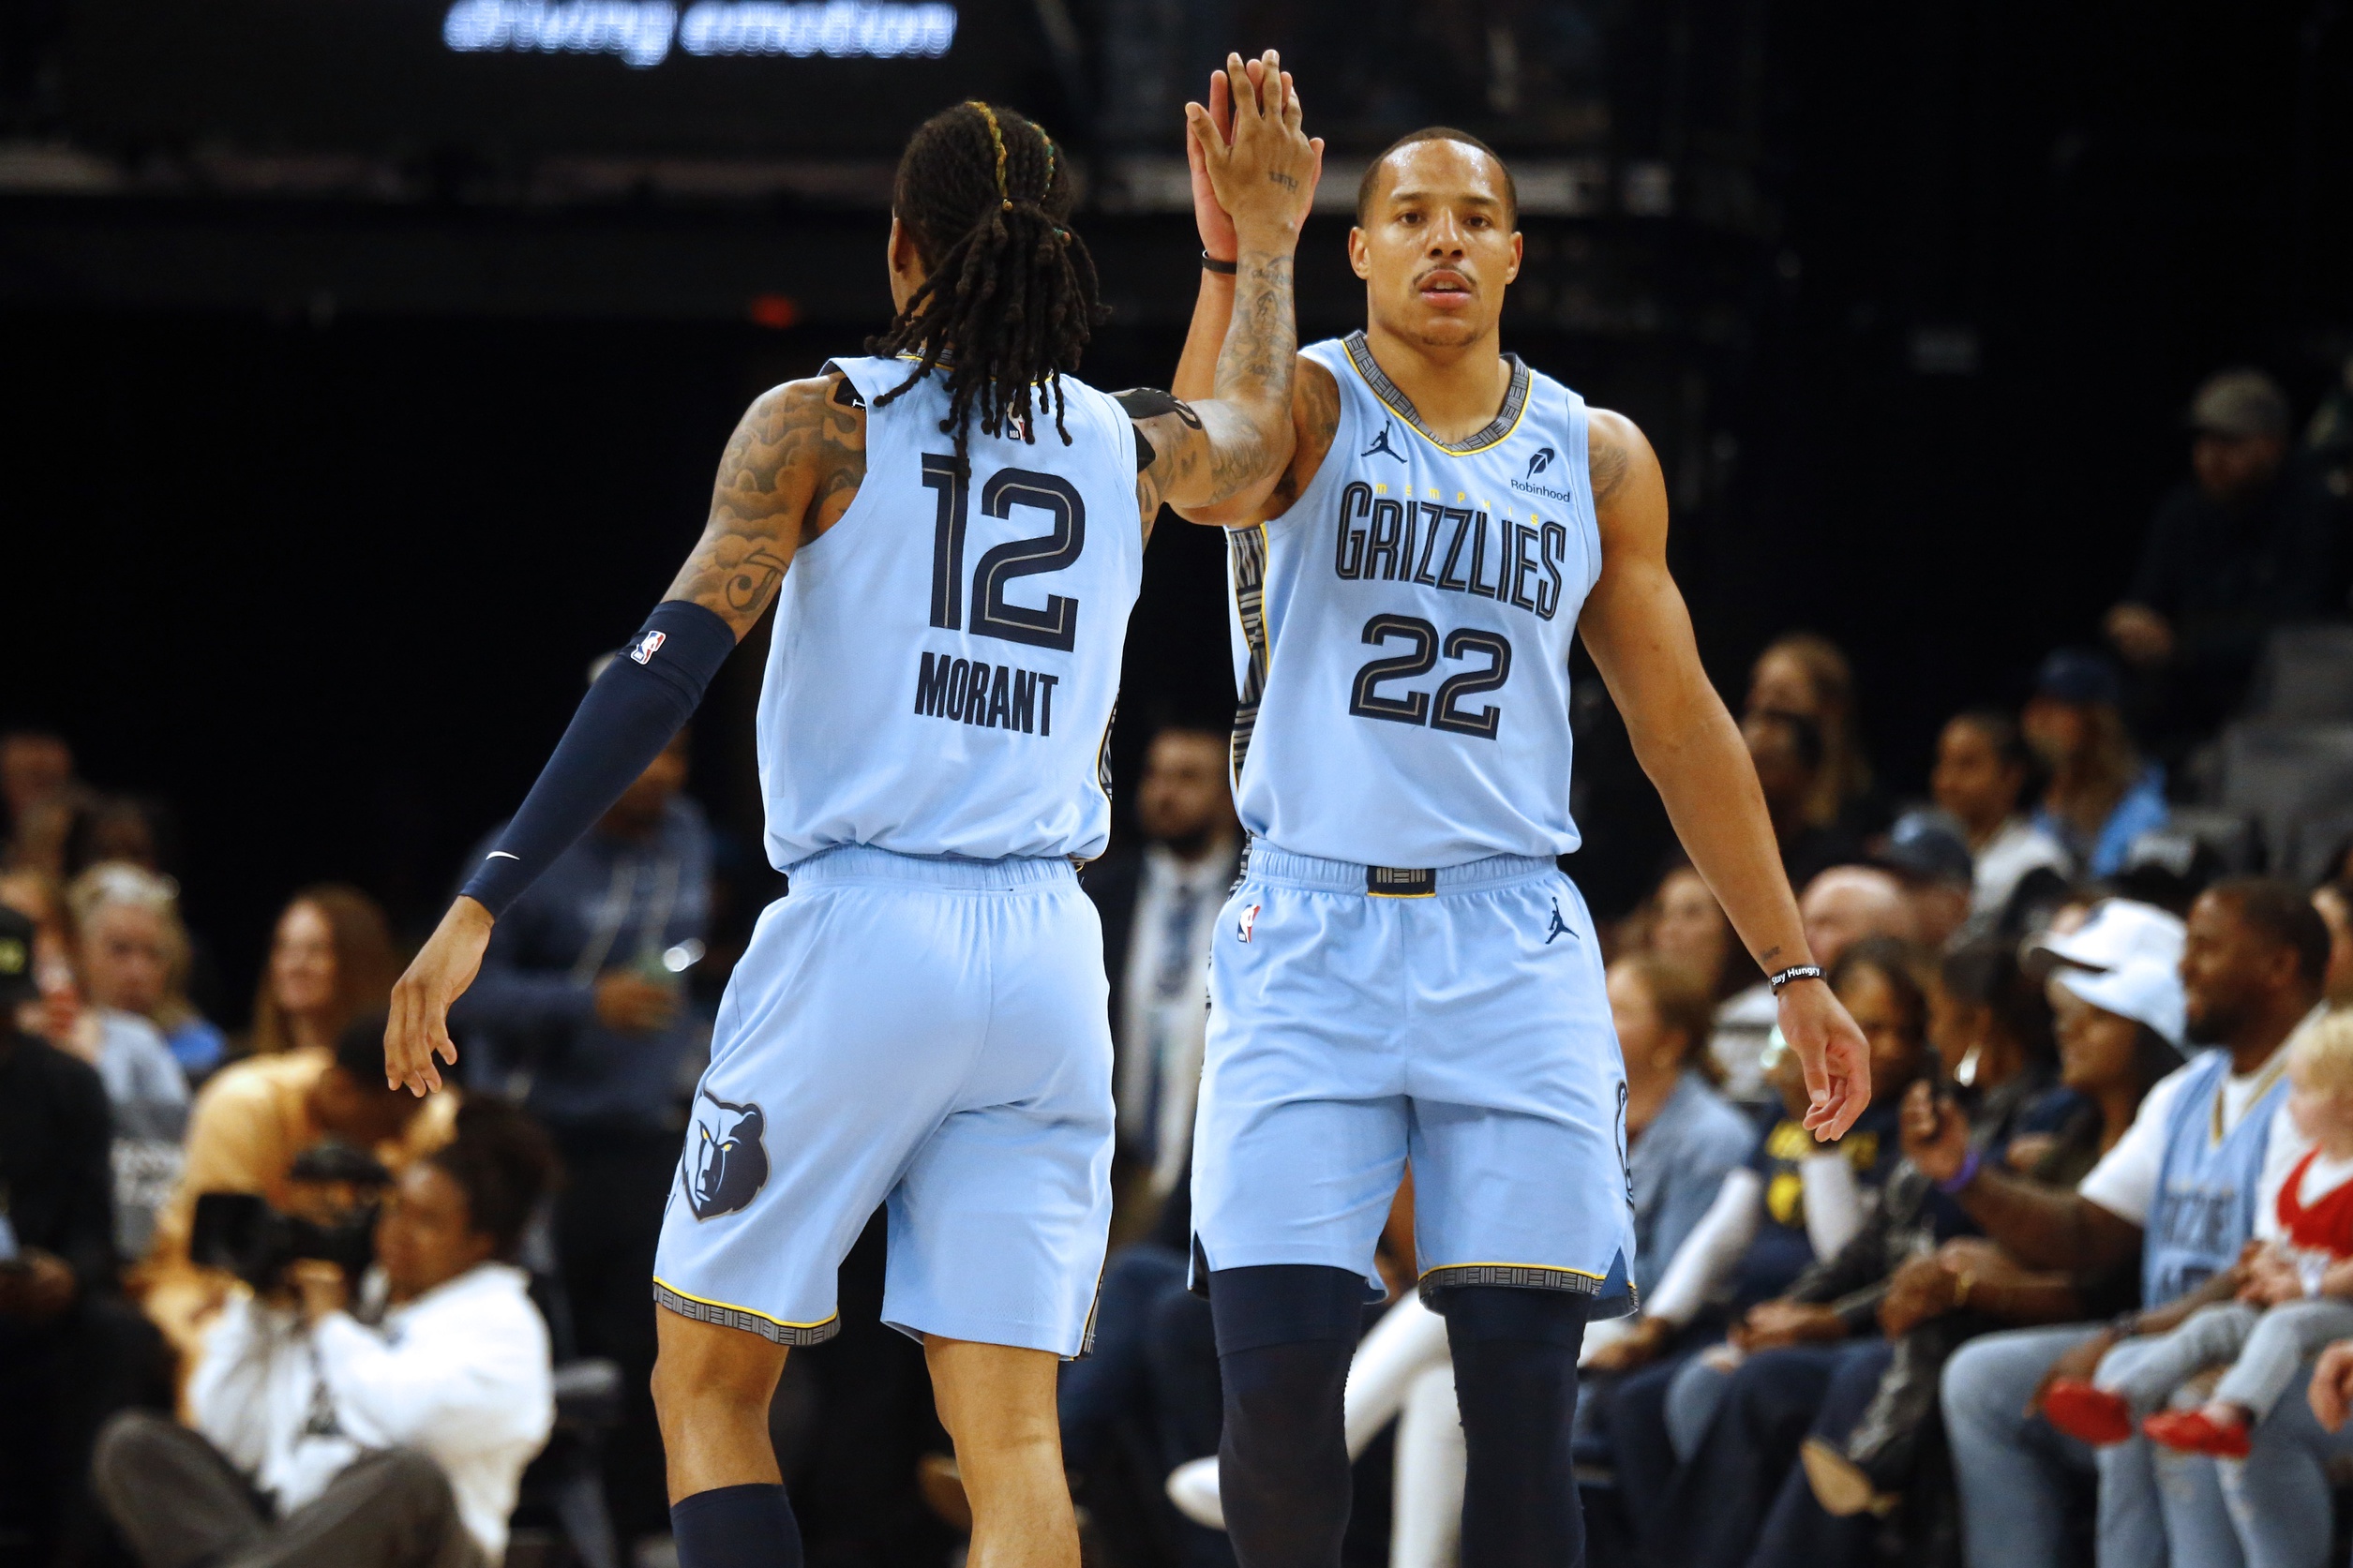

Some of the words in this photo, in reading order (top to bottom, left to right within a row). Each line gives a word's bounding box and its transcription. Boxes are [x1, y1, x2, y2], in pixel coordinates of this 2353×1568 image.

[1510, 479, 1570, 503] Robinhood
[921, 452, 1086, 652] 12
[1335, 481, 1567, 622] GRIZZLIES
[914, 651, 1058, 737] MORANT
[1349, 613, 1512, 740] 22
[1771, 973, 1786, 986] Stay
[1787, 966, 1821, 978] Hungry
